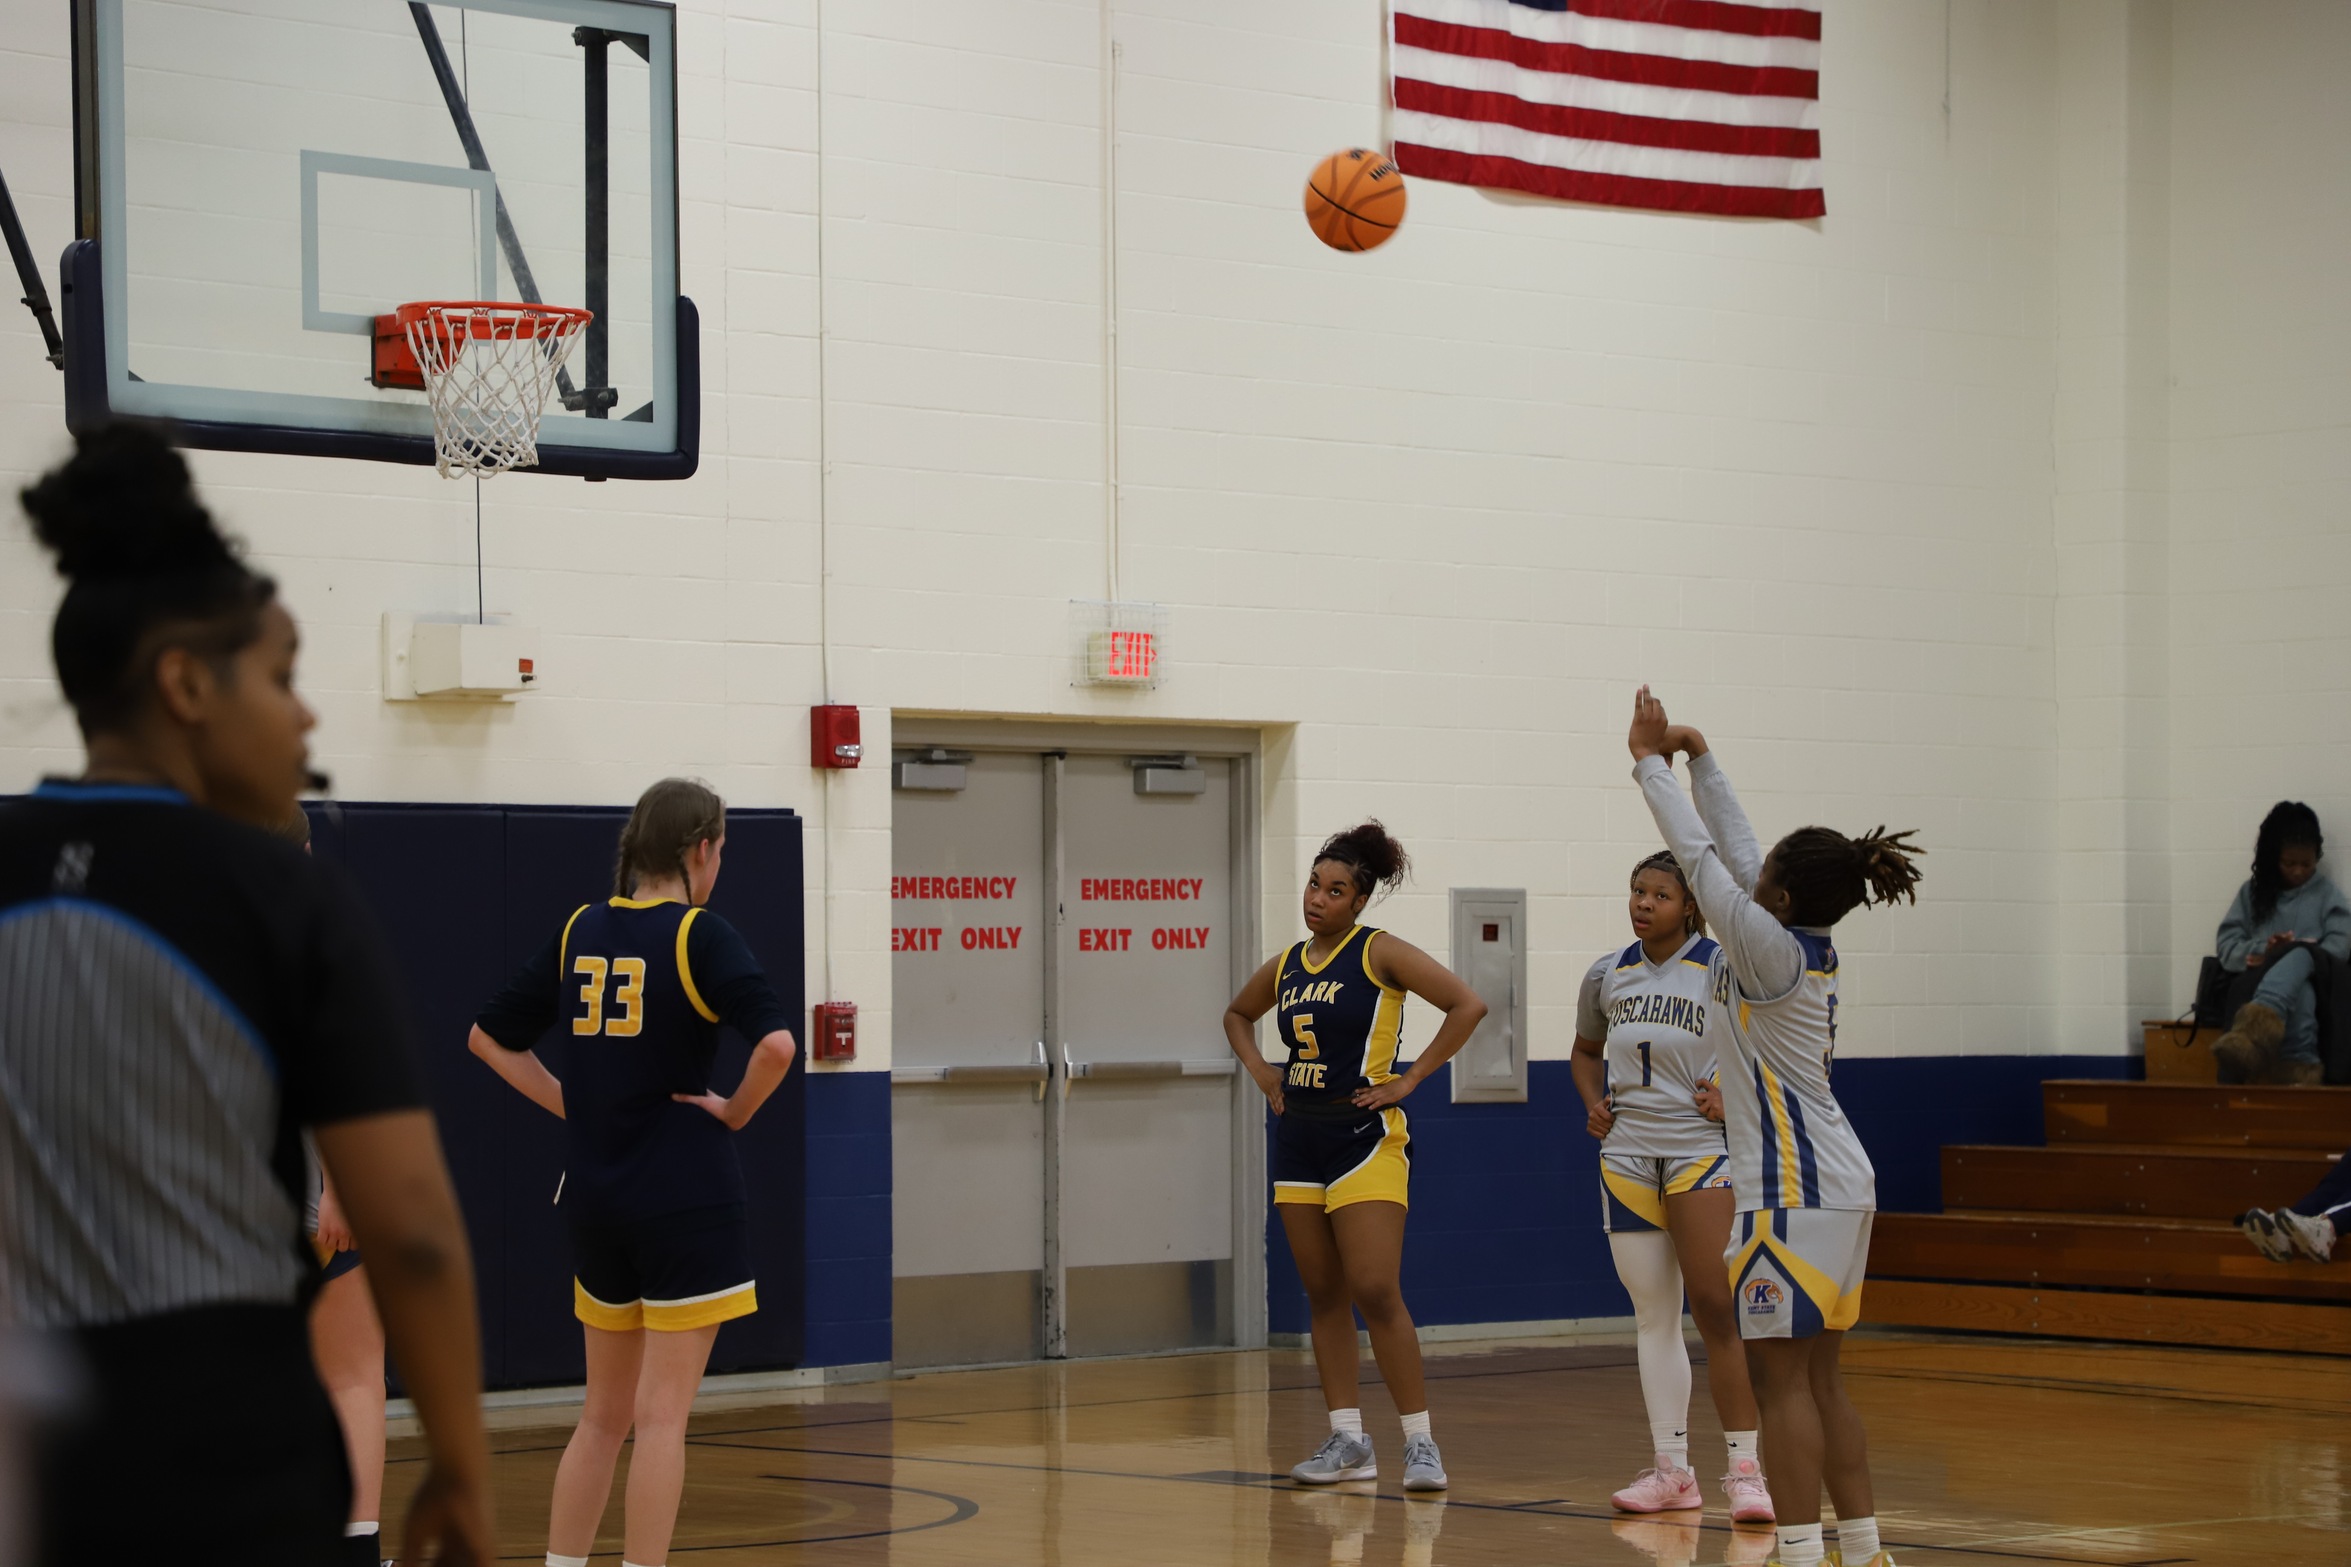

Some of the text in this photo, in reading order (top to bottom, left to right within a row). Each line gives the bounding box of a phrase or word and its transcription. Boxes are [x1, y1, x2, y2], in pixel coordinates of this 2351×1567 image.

[1109, 631, 1152, 678] EXIT
[892, 877, 1016, 899] EMERGENCY
[1081, 879, 1203, 901] EMERGENCY
[892, 927, 1022, 951] EXIT ONLY
[1079, 928, 1210, 951] EXIT ONLY
[573, 956, 646, 1037] 33
[1281, 981, 1344, 1012] CLARK
[1293, 1013, 1320, 1060] 5
[1288, 1062, 1328, 1089] STATE
[1637, 1041, 1652, 1087] 1
[1753, 1285, 1771, 1303] K
